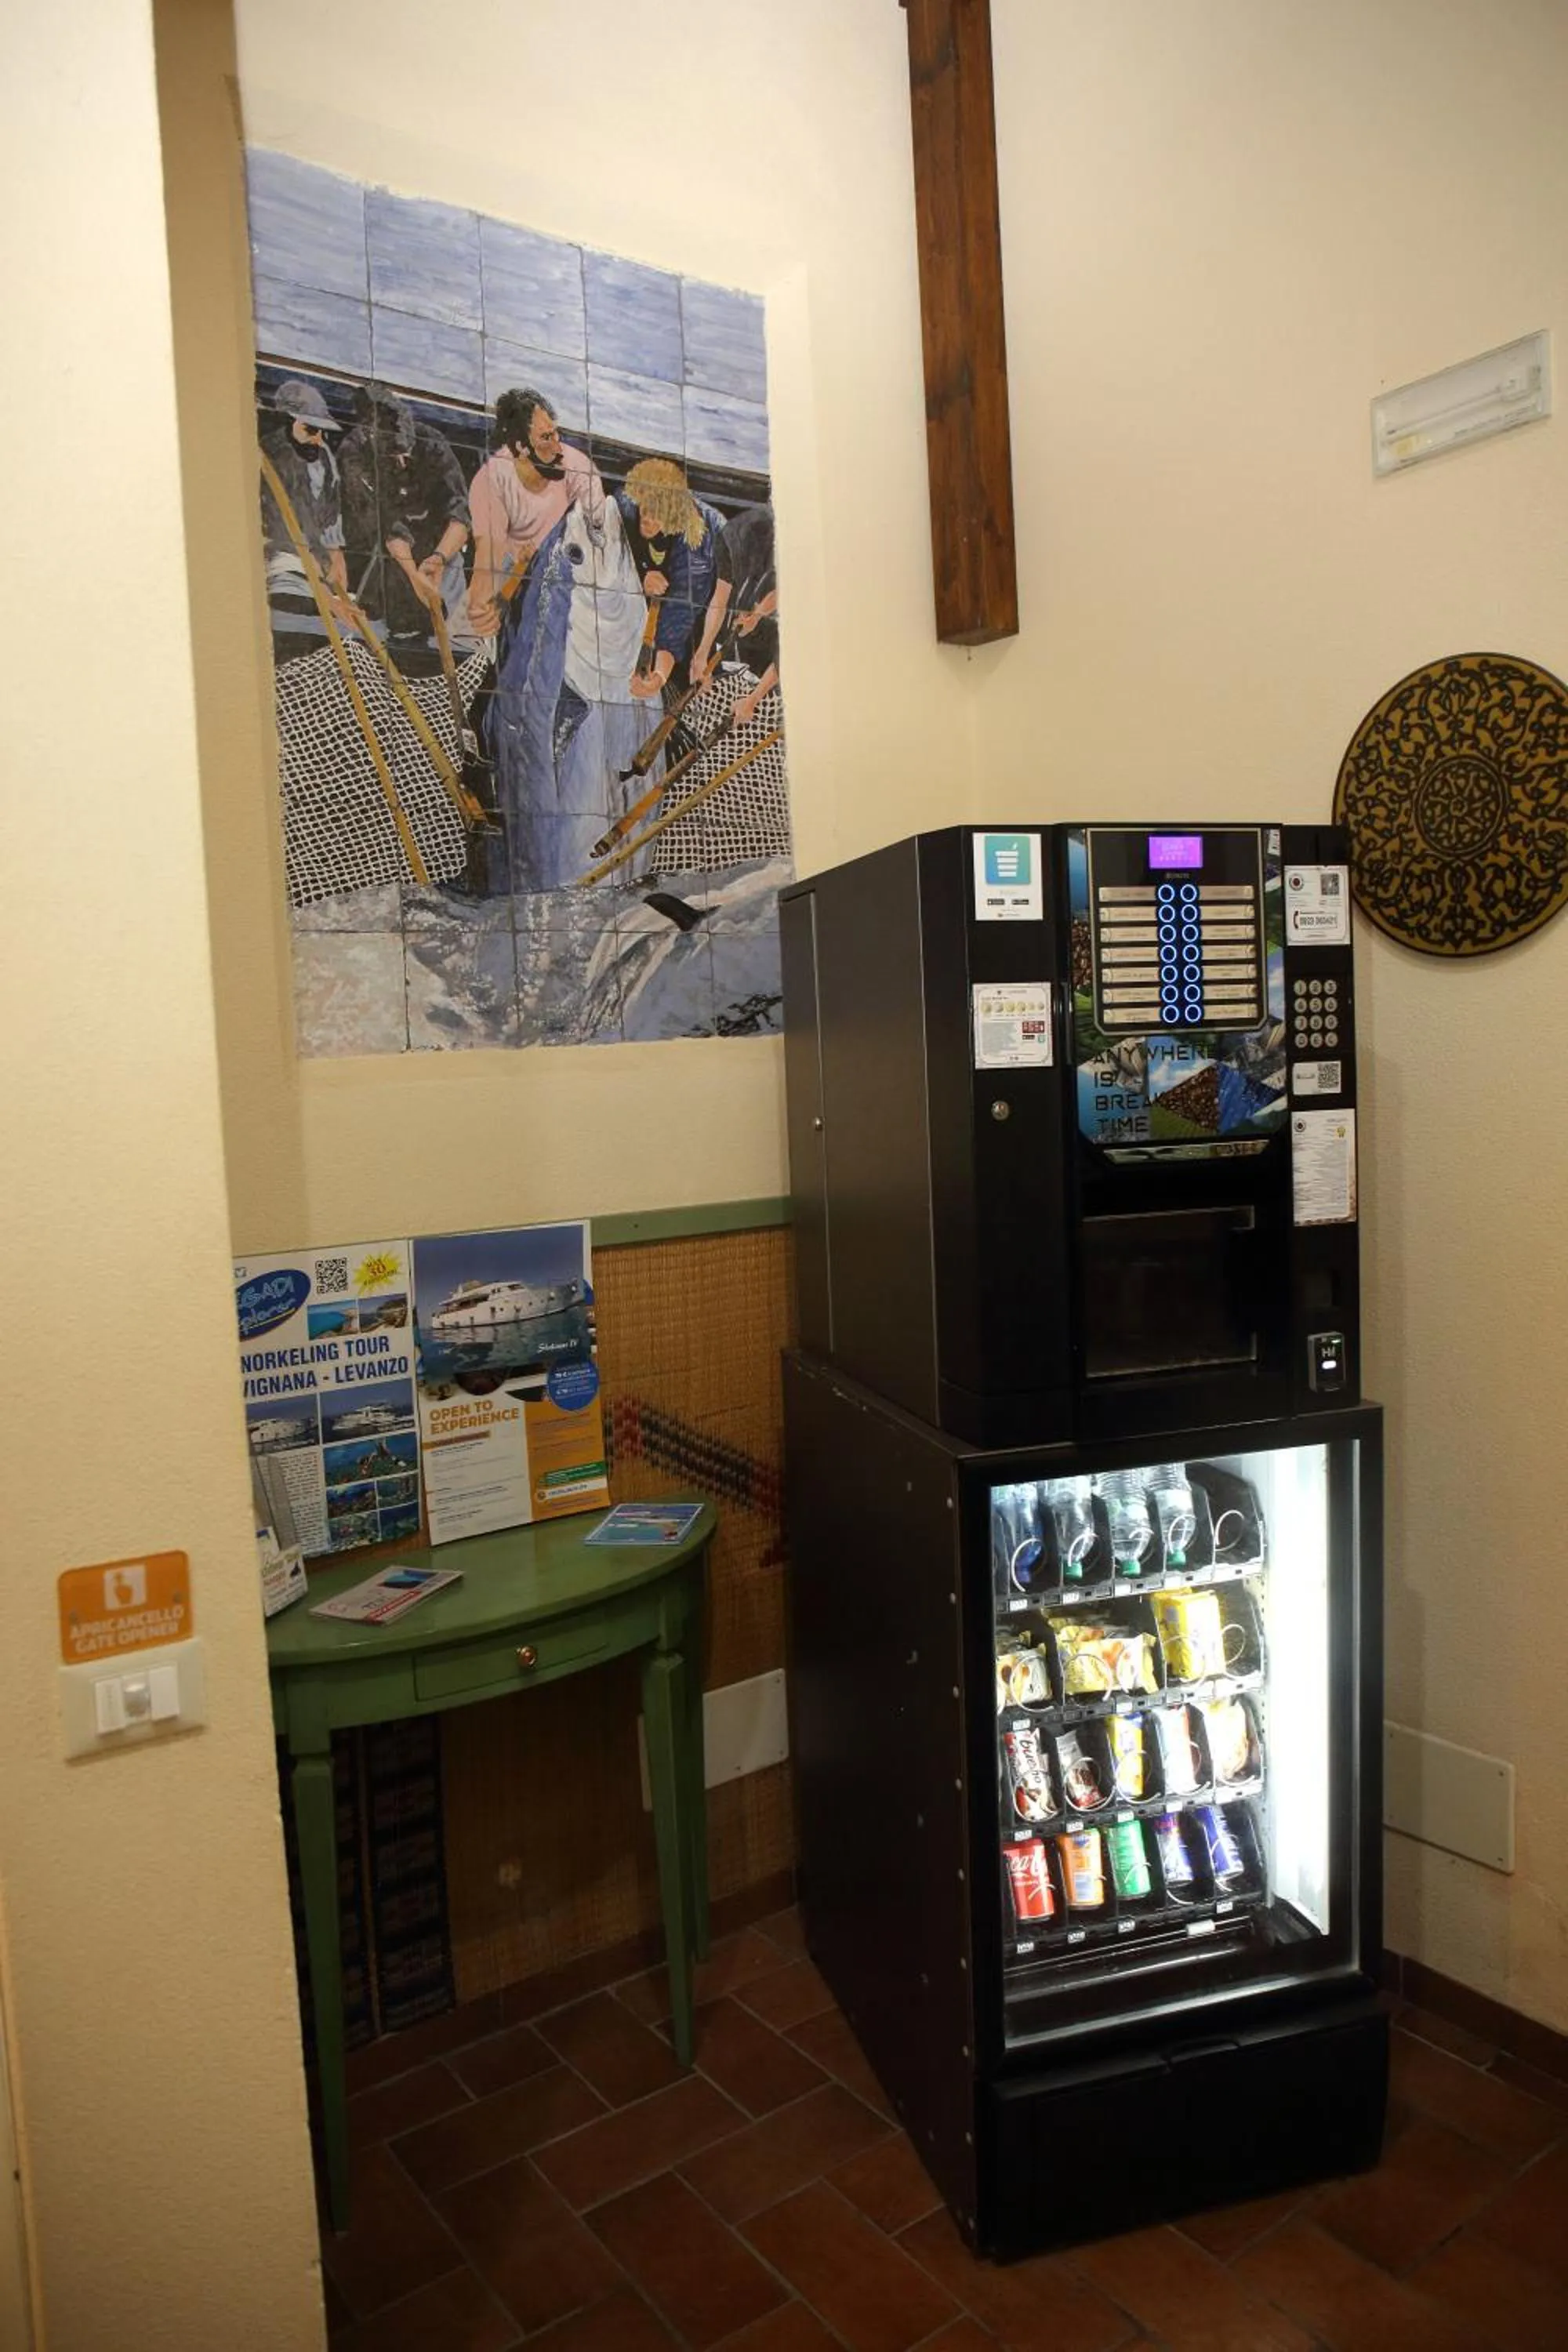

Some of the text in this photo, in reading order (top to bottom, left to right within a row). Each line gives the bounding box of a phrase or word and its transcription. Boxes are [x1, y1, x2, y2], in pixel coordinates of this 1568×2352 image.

[1094, 1044, 1217, 1064] ANYWHERE
[1094, 1072, 1114, 1088] IS
[1094, 1116, 1149, 1134] TIME
[241, 1335, 390, 1374] NORKELING TOUR
[336, 1356, 409, 1384] LEVANZO
[430, 1399, 494, 1421] OPEN TO
[430, 1407, 520, 1436] EXPERIENCE
[74, 1633, 116, 1654] GATE
